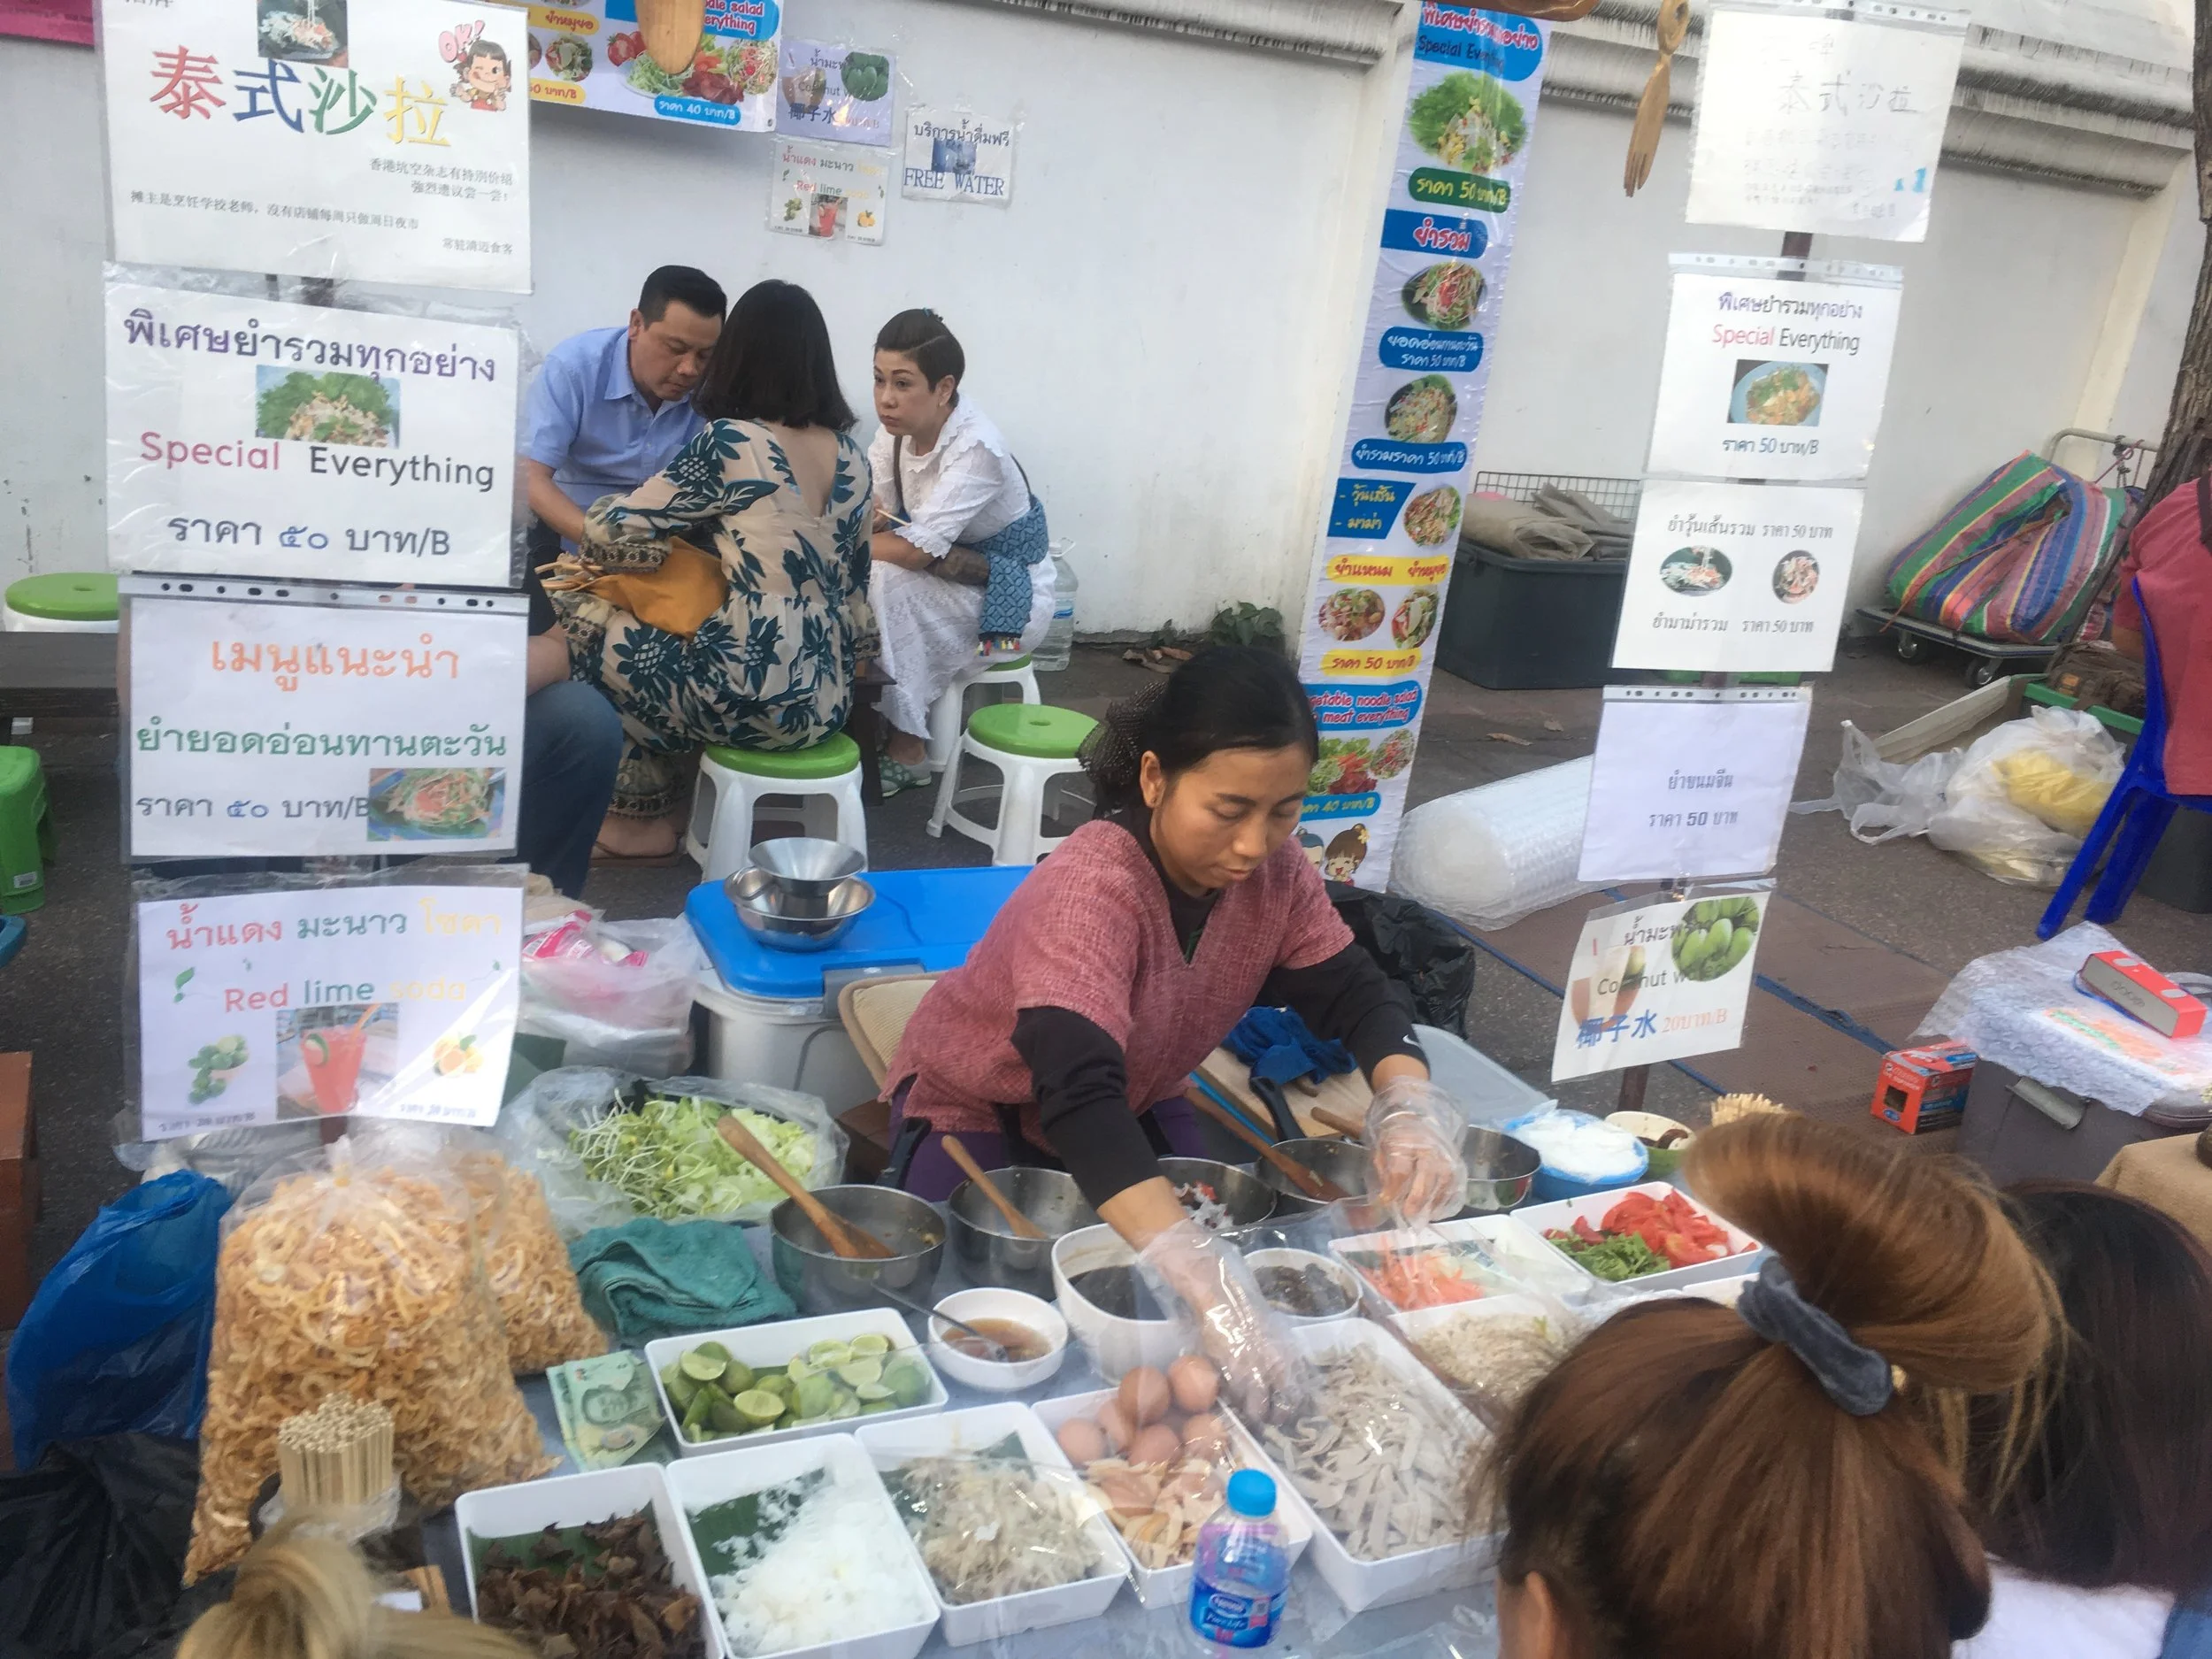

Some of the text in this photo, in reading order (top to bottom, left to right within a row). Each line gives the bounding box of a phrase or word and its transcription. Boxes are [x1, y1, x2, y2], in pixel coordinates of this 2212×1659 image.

[730, 2, 764, 16] salad
[705, 12, 756, 35] erything
[439, 19, 486, 63] OK!
[1417, 35, 1462, 57] Special
[150, 45, 452, 147] 泰式沙拉
[686, 103, 702, 114] 40
[820, 183, 842, 196] lime
[903, 167, 945, 189] FREE
[956, 173, 1005, 196] WATER
[1417, 178, 1454, 196] ราคา
[1413, 217, 1472, 252] ยำรวม
[1718, 291, 1863, 322] พิเศษยำรวมทุกอย่าง
[123, 306, 496, 383] พิเศษยำรวมทุกอย่าง
[1711, 324, 1861, 356] Special Everything
[1722, 438, 1755, 452] ราคา
[1760, 438, 1778, 454] 50
[140, 431, 495, 493] Special Everything
[1348, 512, 1382, 530] มาม่า
[1762, 524, 1790, 538] ราคา
[1792, 525, 1807, 538] 50
[1809, 524, 1833, 539] บาท
[167, 515, 450, 559] ราคา ๕๐ บาท/B
[1741, 619, 1770, 633] ราคา
[1772, 620, 1787, 634] 50
[1789, 619, 1814, 634] บาท
[211, 631, 460, 693] เมนูแนะนำ
[1332, 657, 1361, 669] ราคา
[1364, 657, 1384, 669] 50
[1356, 692, 1392, 706] noodle
[1322, 706, 1356, 724] meat
[136, 714, 508, 758] ยำยอดอ่อนทานตะวัน
[134, 795, 370, 821] ราคา ๕๐ บาท/B
[1649, 810, 1739, 827] ราคา 50 บาท
[166, 902, 284, 951] น้ำแดง
[296, 911, 408, 941] มะนาว
[224, 976, 467, 1013] Red lime soda
